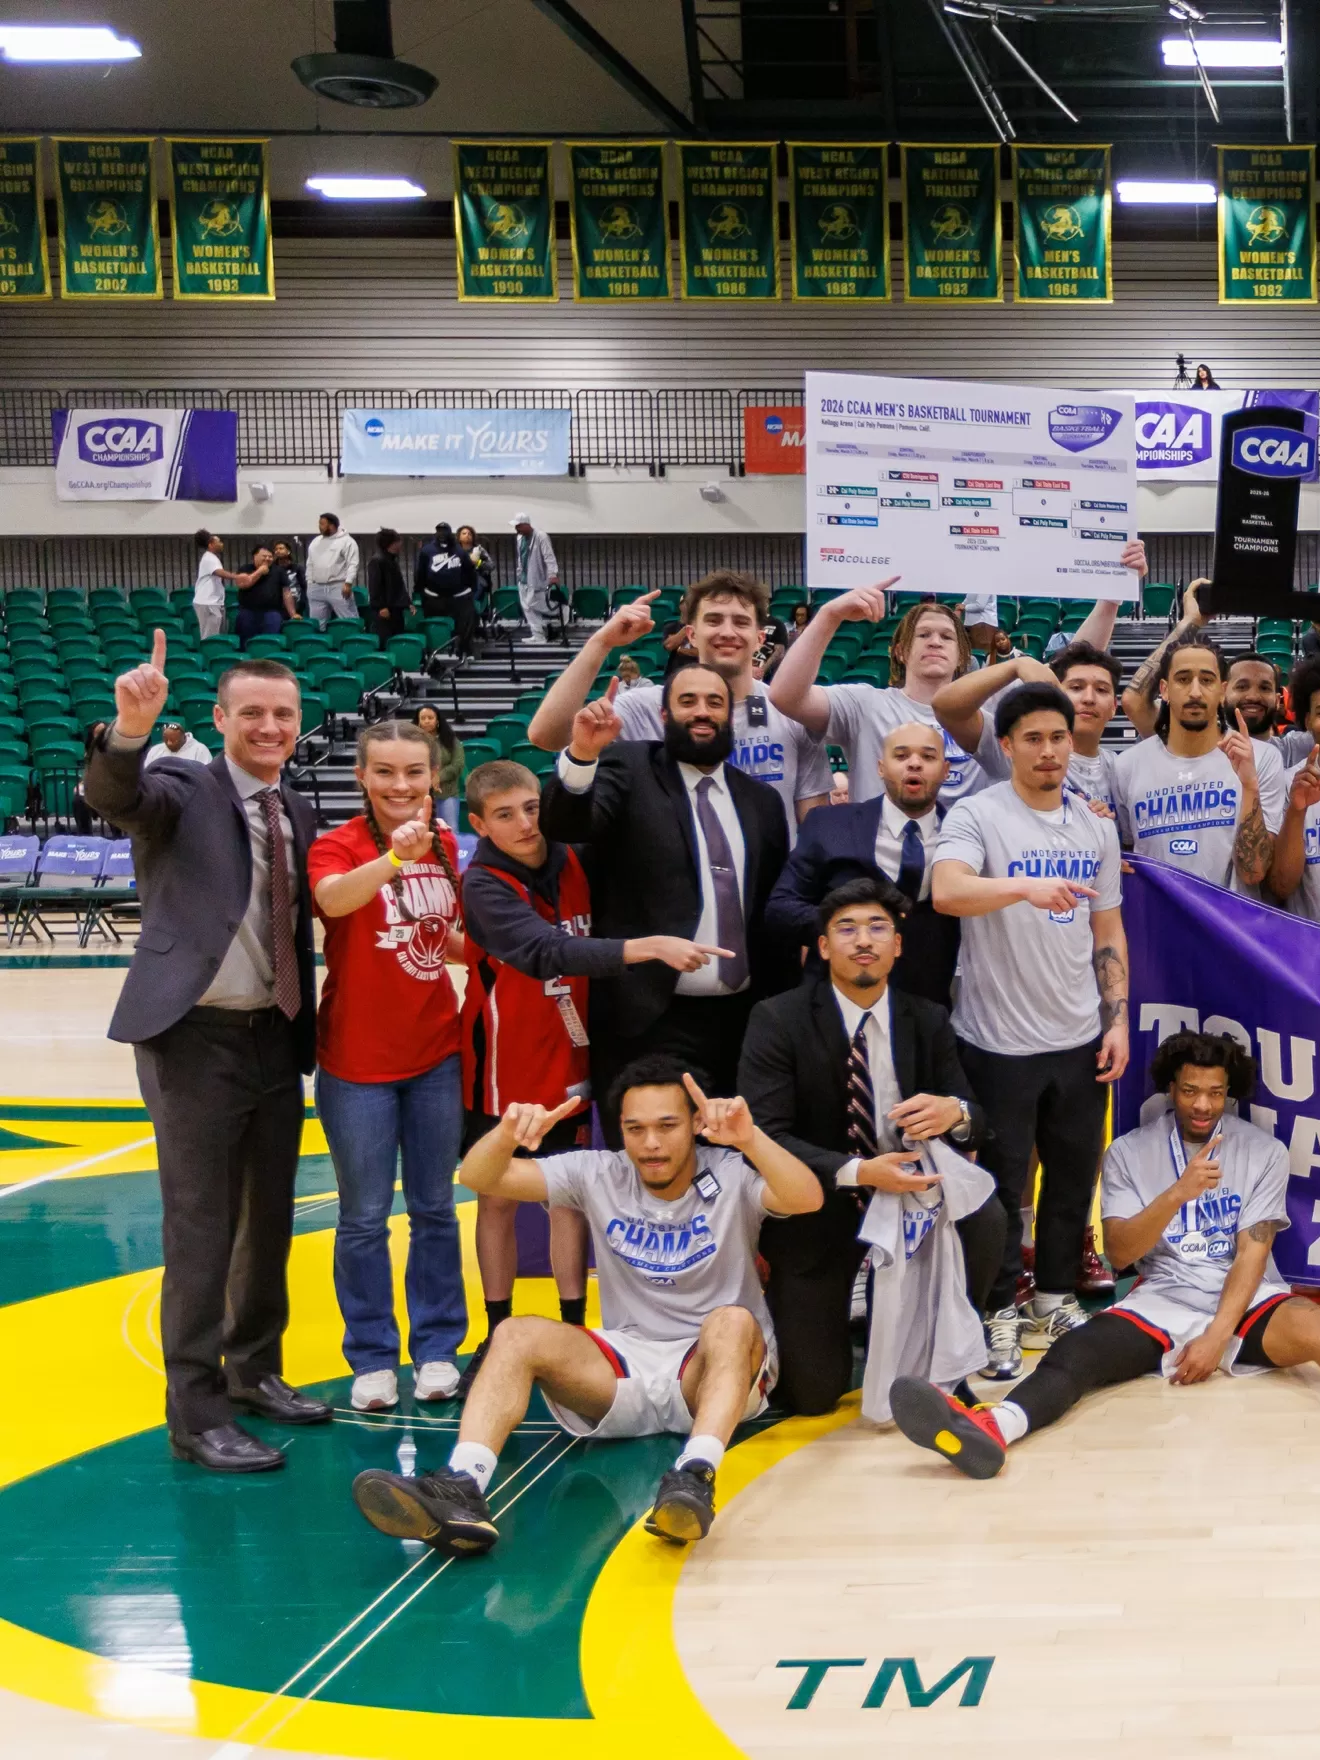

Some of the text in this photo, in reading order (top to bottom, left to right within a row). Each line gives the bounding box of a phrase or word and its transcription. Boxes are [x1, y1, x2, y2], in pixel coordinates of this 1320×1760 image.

[1047, 284, 1078, 296] 1964
[821, 398, 1032, 426] 2026 CCAA MEN'S BASKETBALL TOURNAMENT
[1135, 412, 1202, 448] CAA
[85, 426, 156, 453] CCAA
[382, 421, 548, 460] MAKE IT YOURS
[92, 453, 150, 462] CHAMPIONSHIPS
[1135, 450, 1193, 461] MPIONSHIPS
[1240, 437, 1309, 468] CCAA
[1234, 536, 1279, 545] TOURNAMENT
[1234, 543, 1279, 553] CHAMPIONS
[1146, 780, 1224, 799] UNDISPUTED
[1134, 788, 1236, 830] CHAMPS
[1188, 820, 1231, 830] CHAMPIONS
[1171, 841, 1196, 852] CCAA
[1022, 850, 1096, 858] UNDISPUTED
[606, 1214, 714, 1263] CHAMS
[1182, 1244, 1207, 1253] CCAA
[1209, 1242, 1230, 1252] CCAA
[775, 1656, 996, 1710] TM
